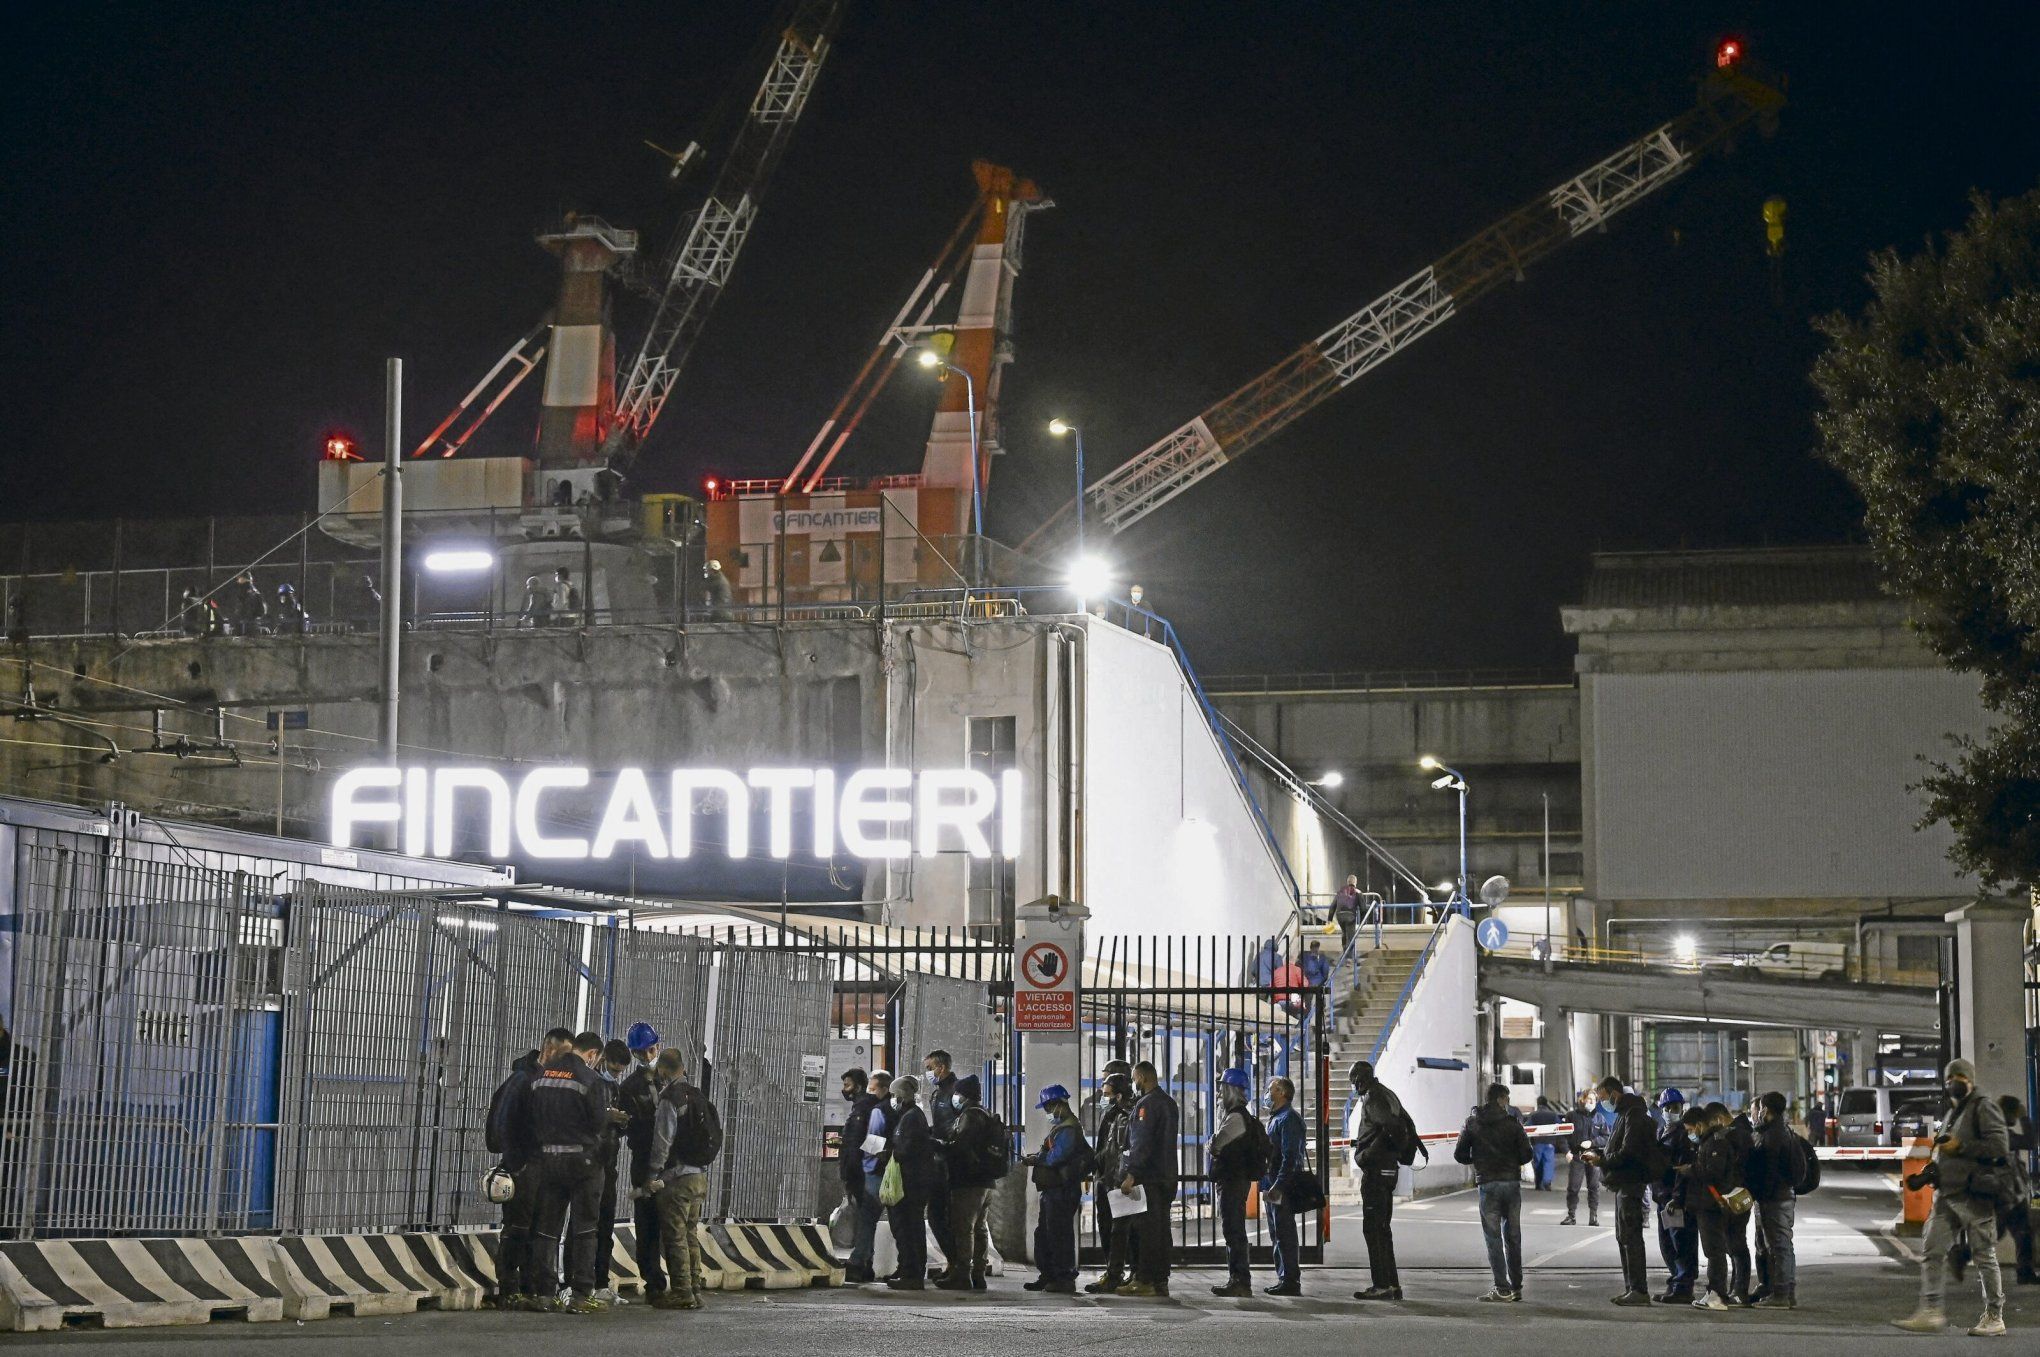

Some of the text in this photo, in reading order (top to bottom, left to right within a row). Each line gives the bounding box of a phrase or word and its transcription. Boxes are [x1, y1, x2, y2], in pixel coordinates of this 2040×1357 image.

[787, 511, 882, 527] FINCANTIER
[332, 767, 1021, 859] FINCANTIERI
[1025, 993, 1064, 1001] VIETATO
